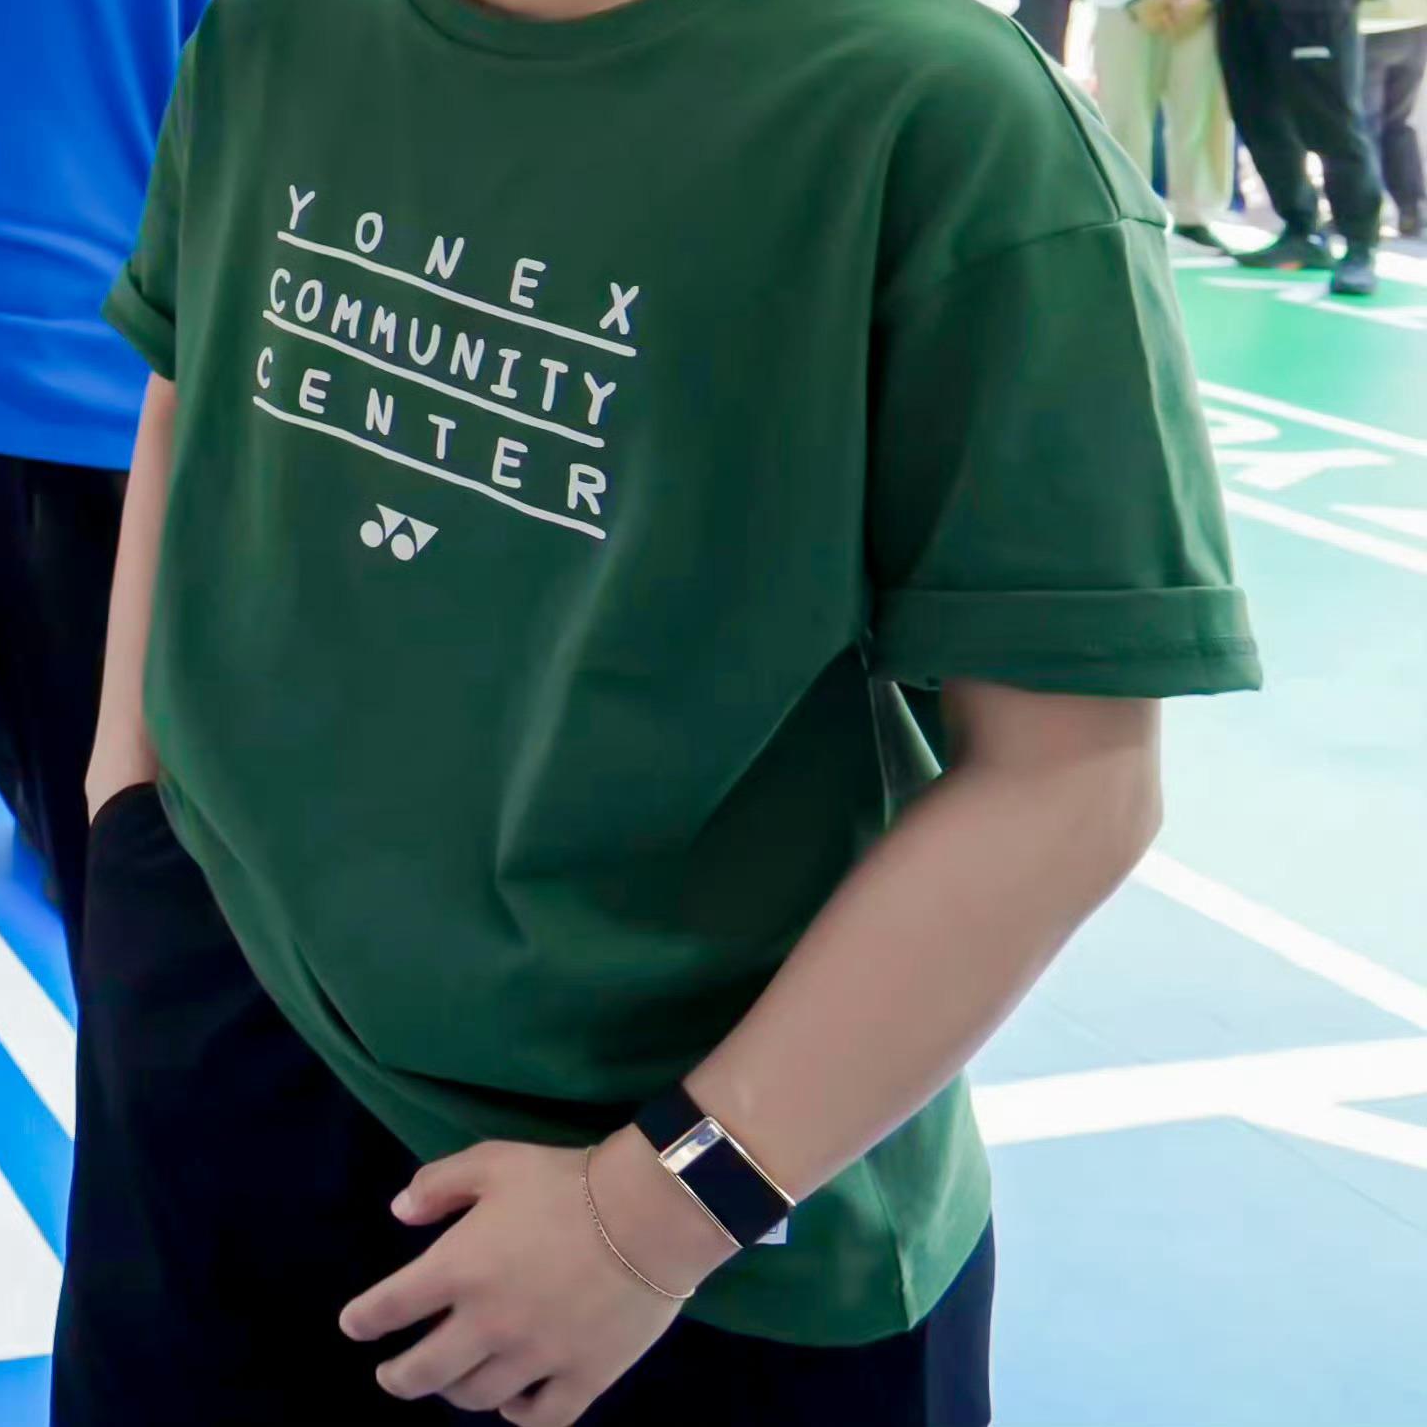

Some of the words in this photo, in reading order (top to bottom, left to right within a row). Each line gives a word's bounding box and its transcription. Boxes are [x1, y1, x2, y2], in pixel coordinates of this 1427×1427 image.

[287, 183, 640, 336] YONEX
[269, 267, 617, 426] COMMUNITY
[254, 346, 607, 516] CENTER
